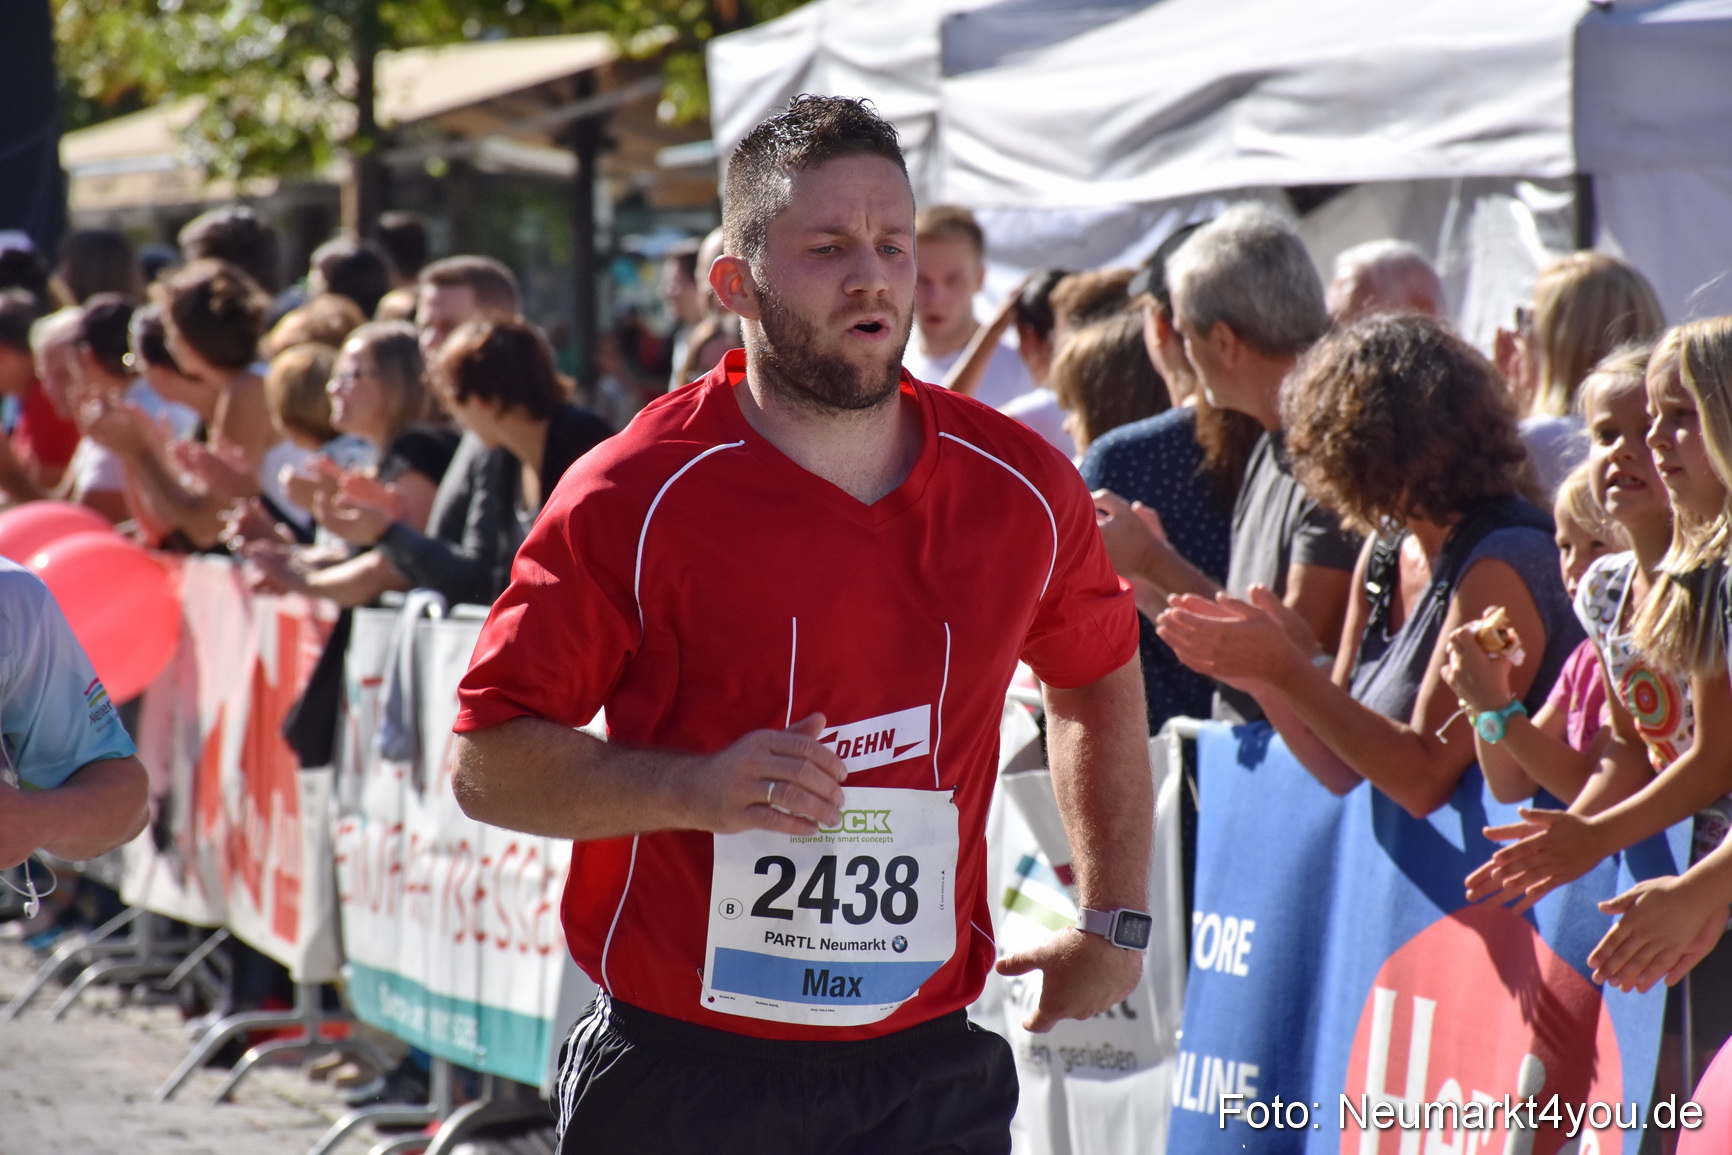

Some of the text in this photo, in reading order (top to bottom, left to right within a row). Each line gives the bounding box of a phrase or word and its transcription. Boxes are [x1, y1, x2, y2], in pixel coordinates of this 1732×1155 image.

[836, 728, 896, 760] DEHN
[789, 835, 894, 845] inspired by smart concepts
[751, 855, 920, 925] 2438
[764, 930, 816, 950] PARTL
[820, 937, 887, 951] Neumarkt
[802, 967, 864, 998] Max
